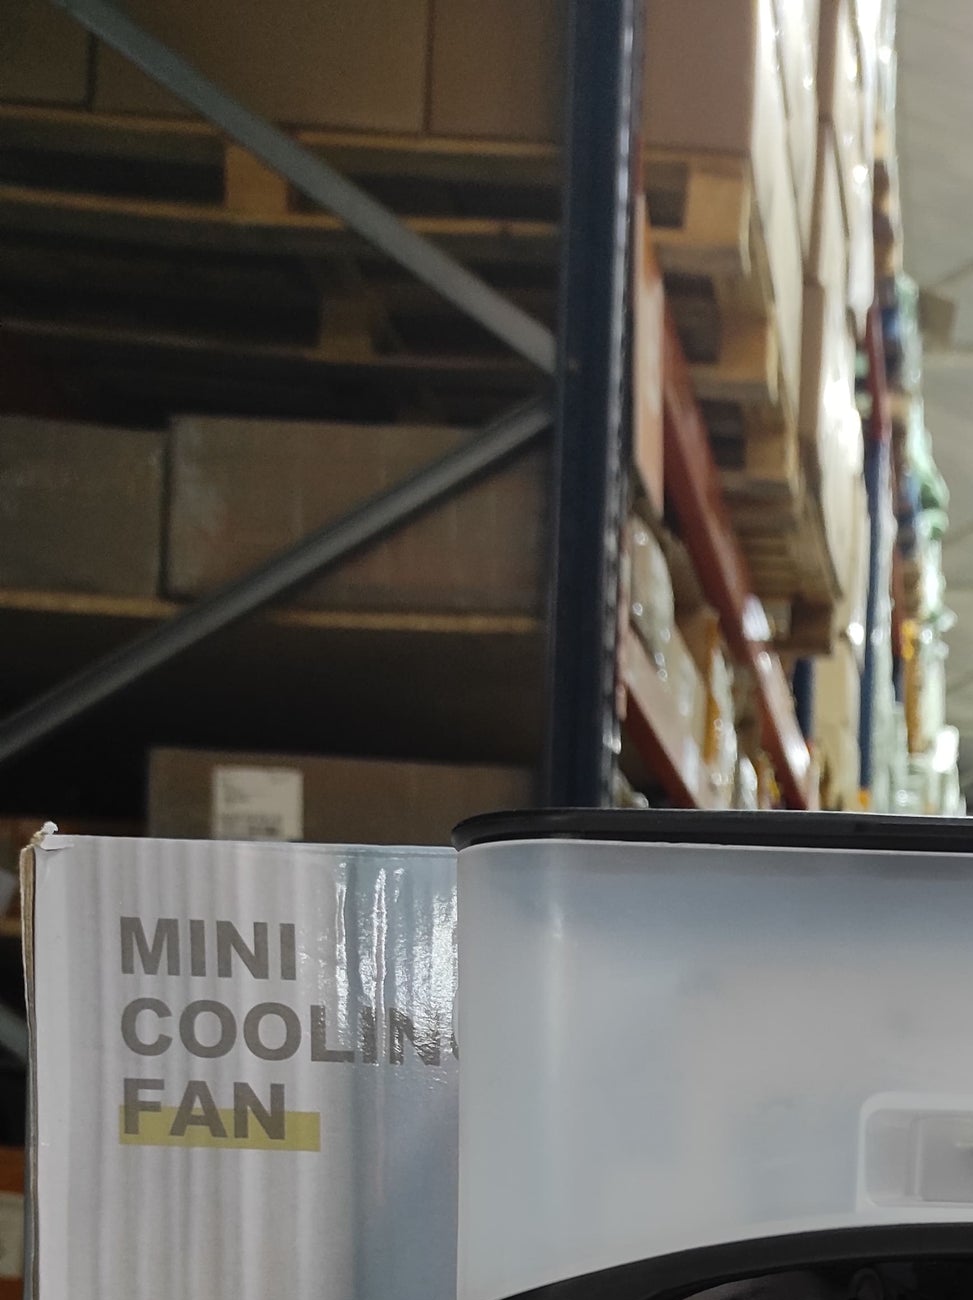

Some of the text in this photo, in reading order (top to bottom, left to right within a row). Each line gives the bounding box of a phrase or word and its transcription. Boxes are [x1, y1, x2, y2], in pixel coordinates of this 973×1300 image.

[120, 916, 297, 981] MINI
[120, 997, 459, 1067] COOLIN
[122, 1077, 286, 1140] FAN
